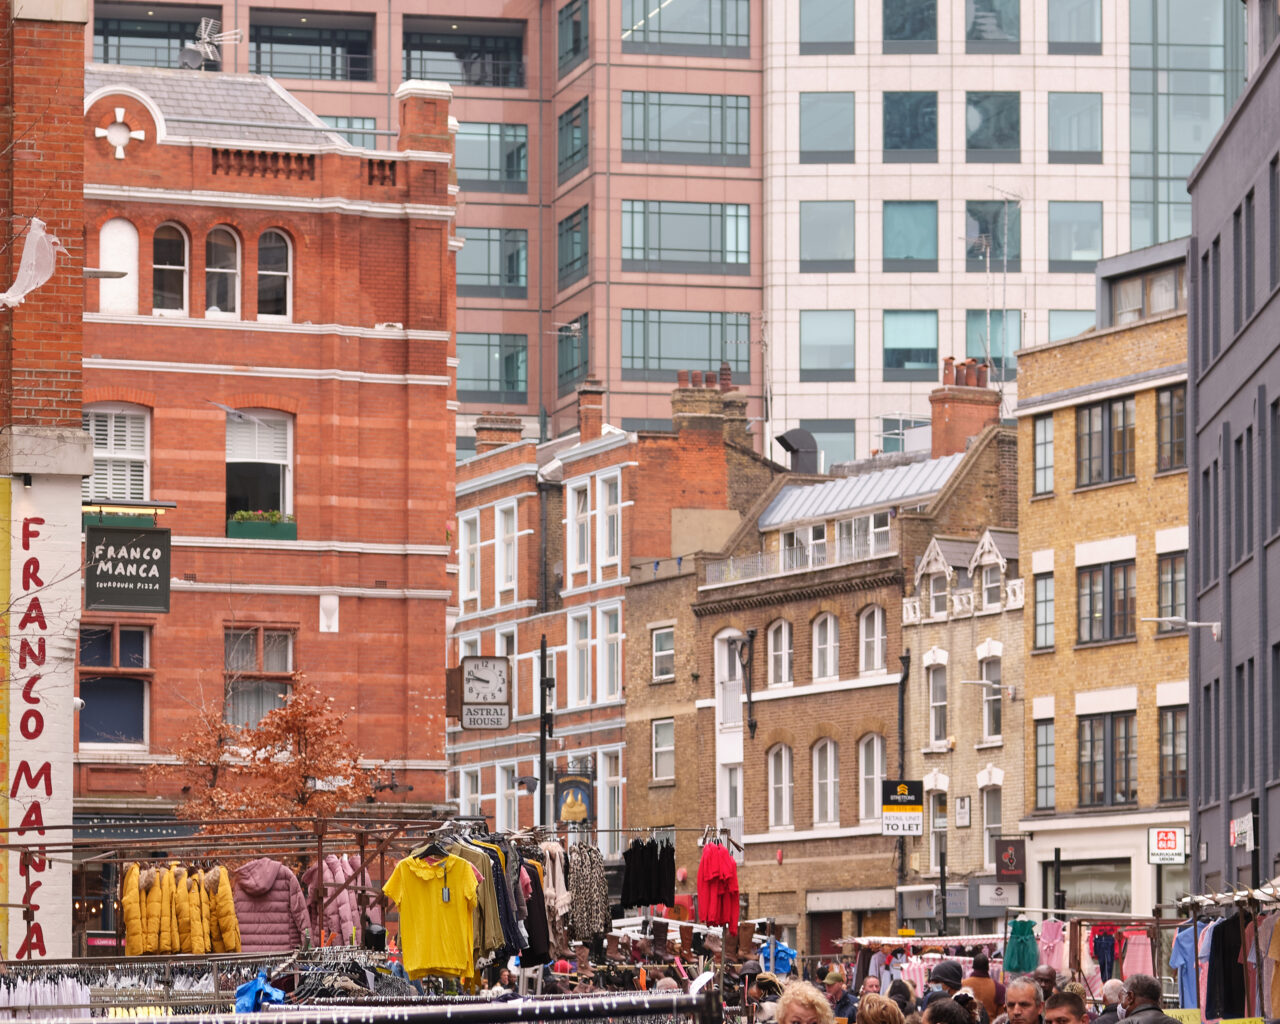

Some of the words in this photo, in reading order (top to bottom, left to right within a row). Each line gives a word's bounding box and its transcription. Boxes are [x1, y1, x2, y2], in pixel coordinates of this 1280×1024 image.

[95, 545, 162, 560] FRANCO
[96, 560, 160, 578] MANCA
[96, 581, 134, 589] SOURDOUGH
[136, 582, 159, 590] PIZZA
[18, 517, 48, 740] FRANCO
[465, 708, 506, 716] ASTRAL
[469, 717, 503, 726] HOUSE
[885, 823, 899, 832] TO
[902, 823, 921, 832] LET
[9, 760, 53, 959] MANCA
